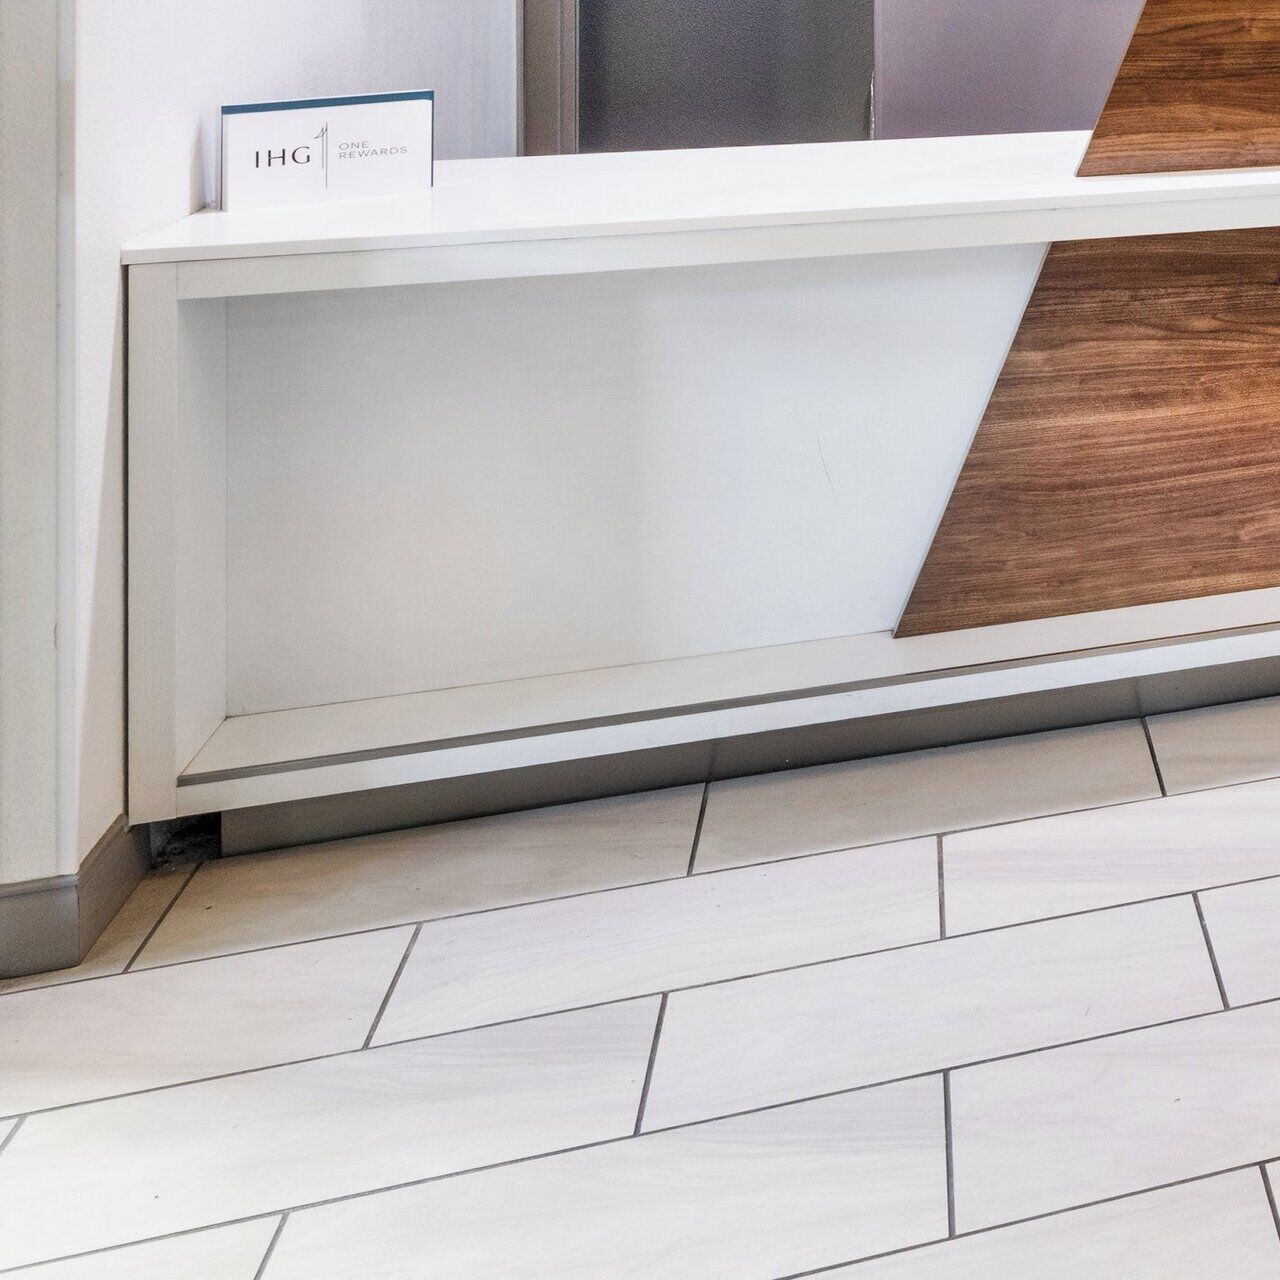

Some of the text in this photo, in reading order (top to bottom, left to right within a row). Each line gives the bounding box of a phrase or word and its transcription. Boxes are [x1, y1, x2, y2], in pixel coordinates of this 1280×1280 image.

[338, 140, 369, 151] ONE
[338, 145, 408, 160] REWARDS
[255, 146, 310, 168] IHG
